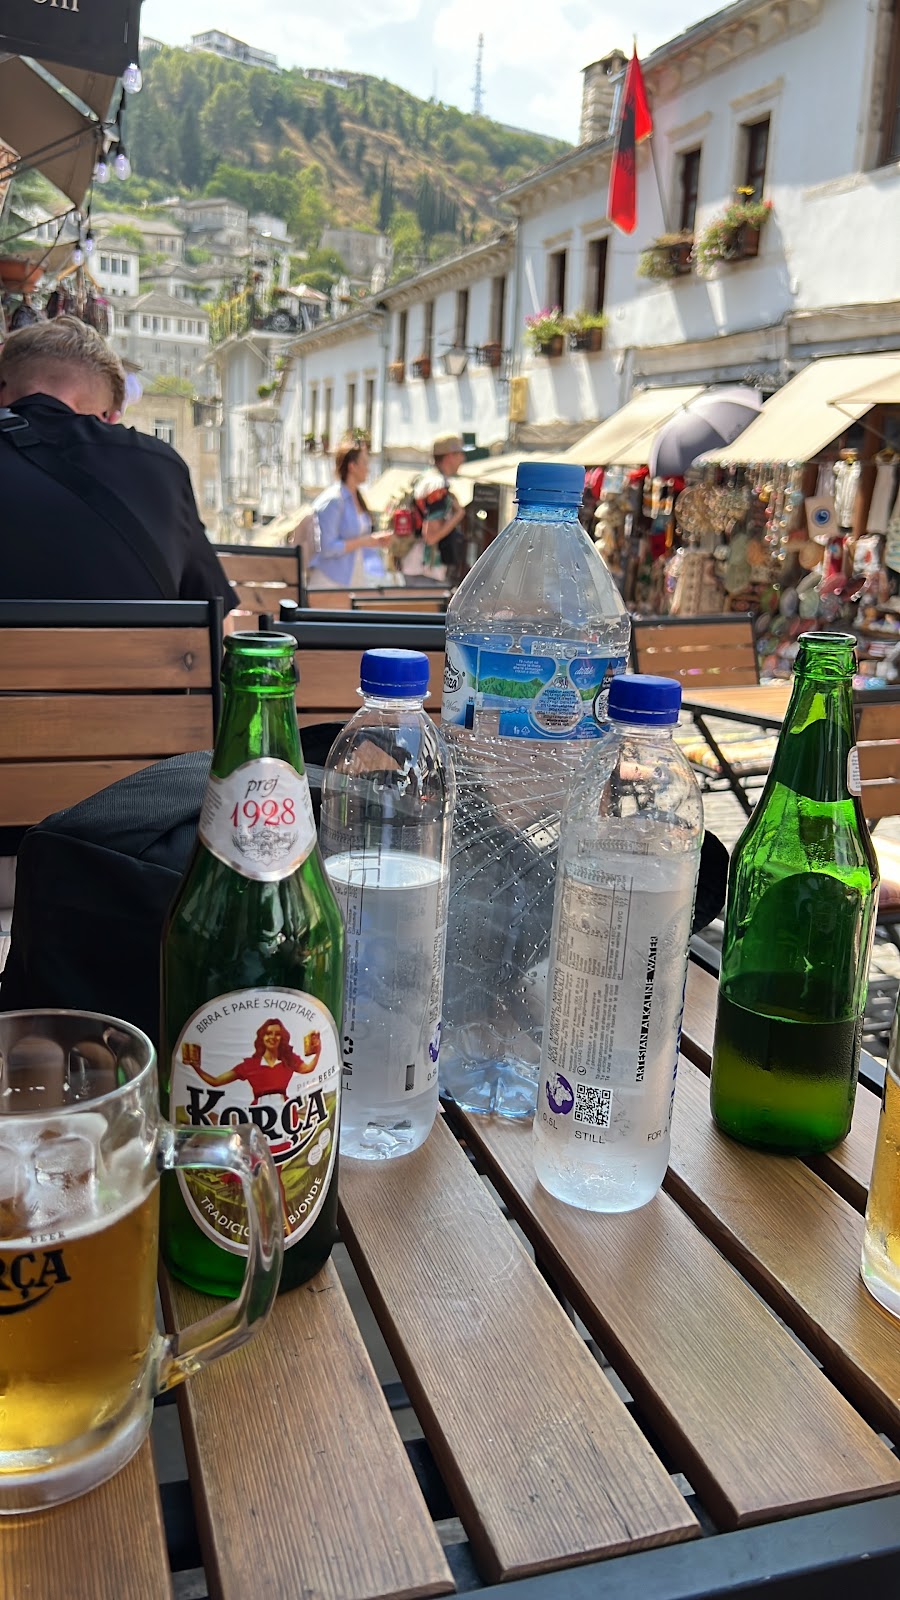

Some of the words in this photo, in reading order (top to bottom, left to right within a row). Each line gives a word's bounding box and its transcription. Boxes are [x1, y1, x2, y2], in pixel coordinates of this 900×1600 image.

[245, 775, 279, 799] prej
[230, 798, 296, 828] 1928
[647, 936, 658, 973] WATER
[195, 1011, 222, 1034] BIRRA
[222, 1006, 231, 1016] E
[231, 998, 260, 1013] PARË
[263, 998, 316, 1022] SHQIPTARE
[641, 979, 654, 1028] ALKALINE
[636, 1033, 648, 1081] ARTESIAN
[318, 1065, 336, 1083] BEER
[542, 1112, 558, 1130] 0.5L
[574, 1130, 605, 1144] STILL
[647, 1129, 662, 1141] FOR
[288, 1176, 322, 1225] BJONDE
[31, 1231, 66, 1243] BEER
